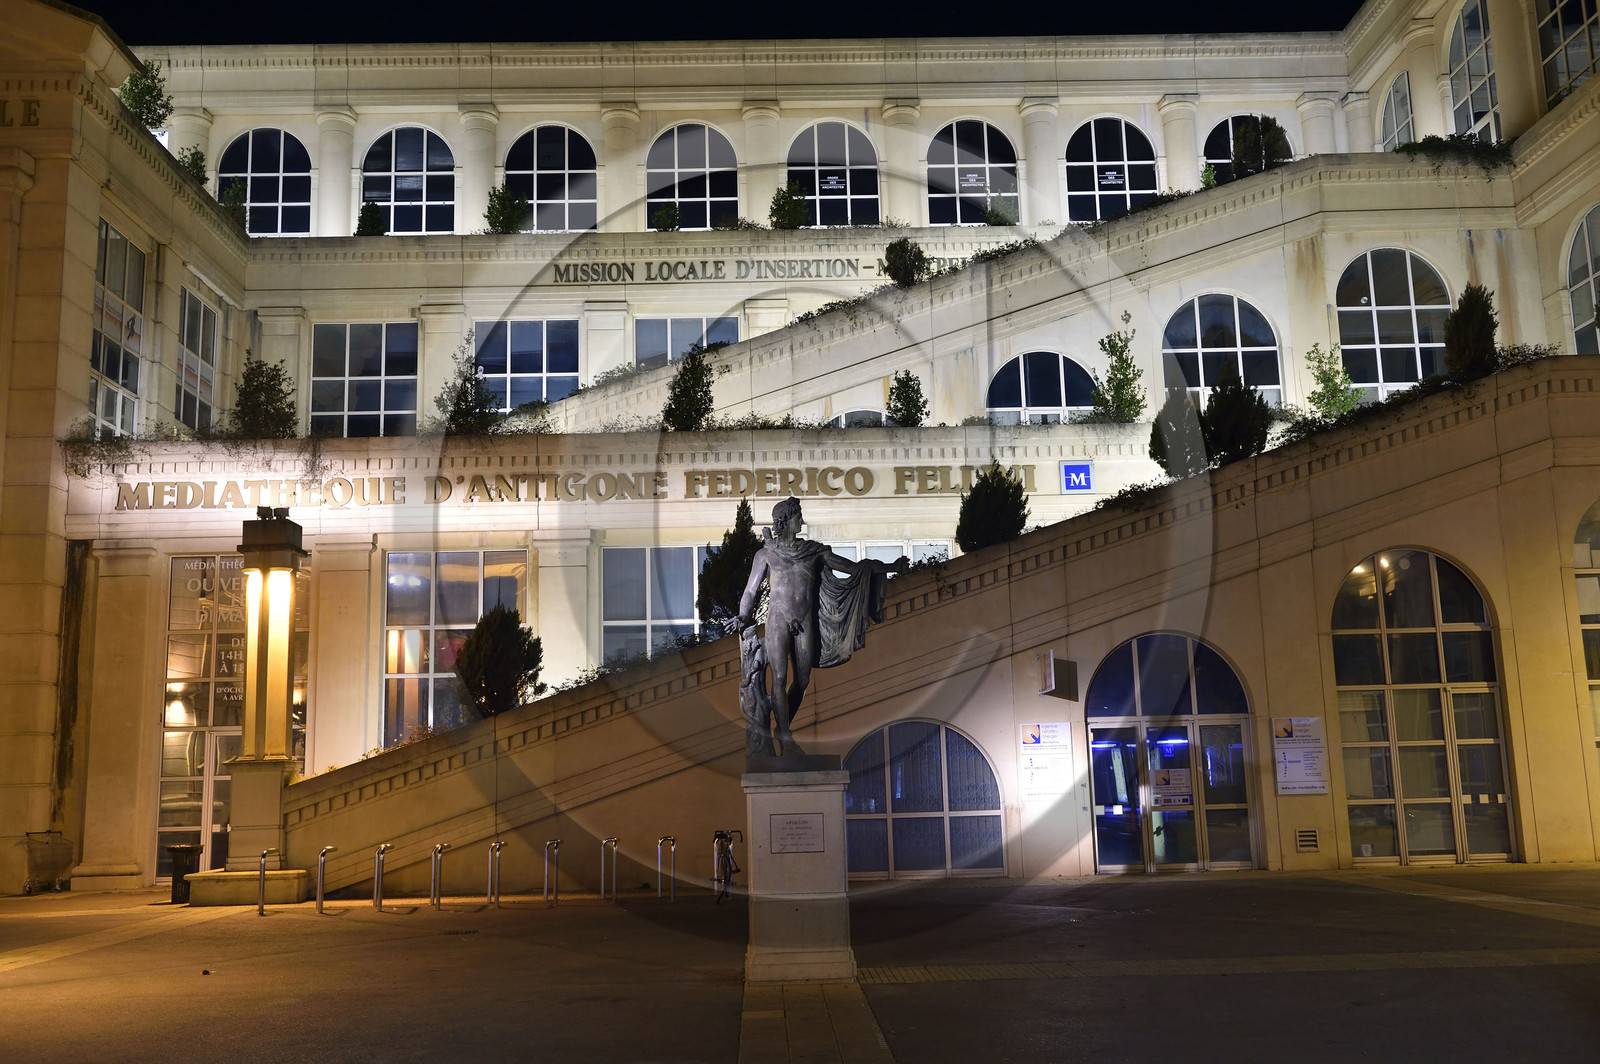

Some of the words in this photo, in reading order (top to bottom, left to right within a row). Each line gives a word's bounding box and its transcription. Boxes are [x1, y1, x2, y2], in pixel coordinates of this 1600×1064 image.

[553, 262, 635, 283] MISSION
[645, 260, 726, 282] LOCALE
[736, 258, 859, 280] D'INSERTION
[115, 476, 405, 511] MEDIATHEQUE
[424, 472, 668, 504] D'ANTIGONE
[684, 466, 874, 499] FEDERICO
[1069, 472, 1087, 487] M
